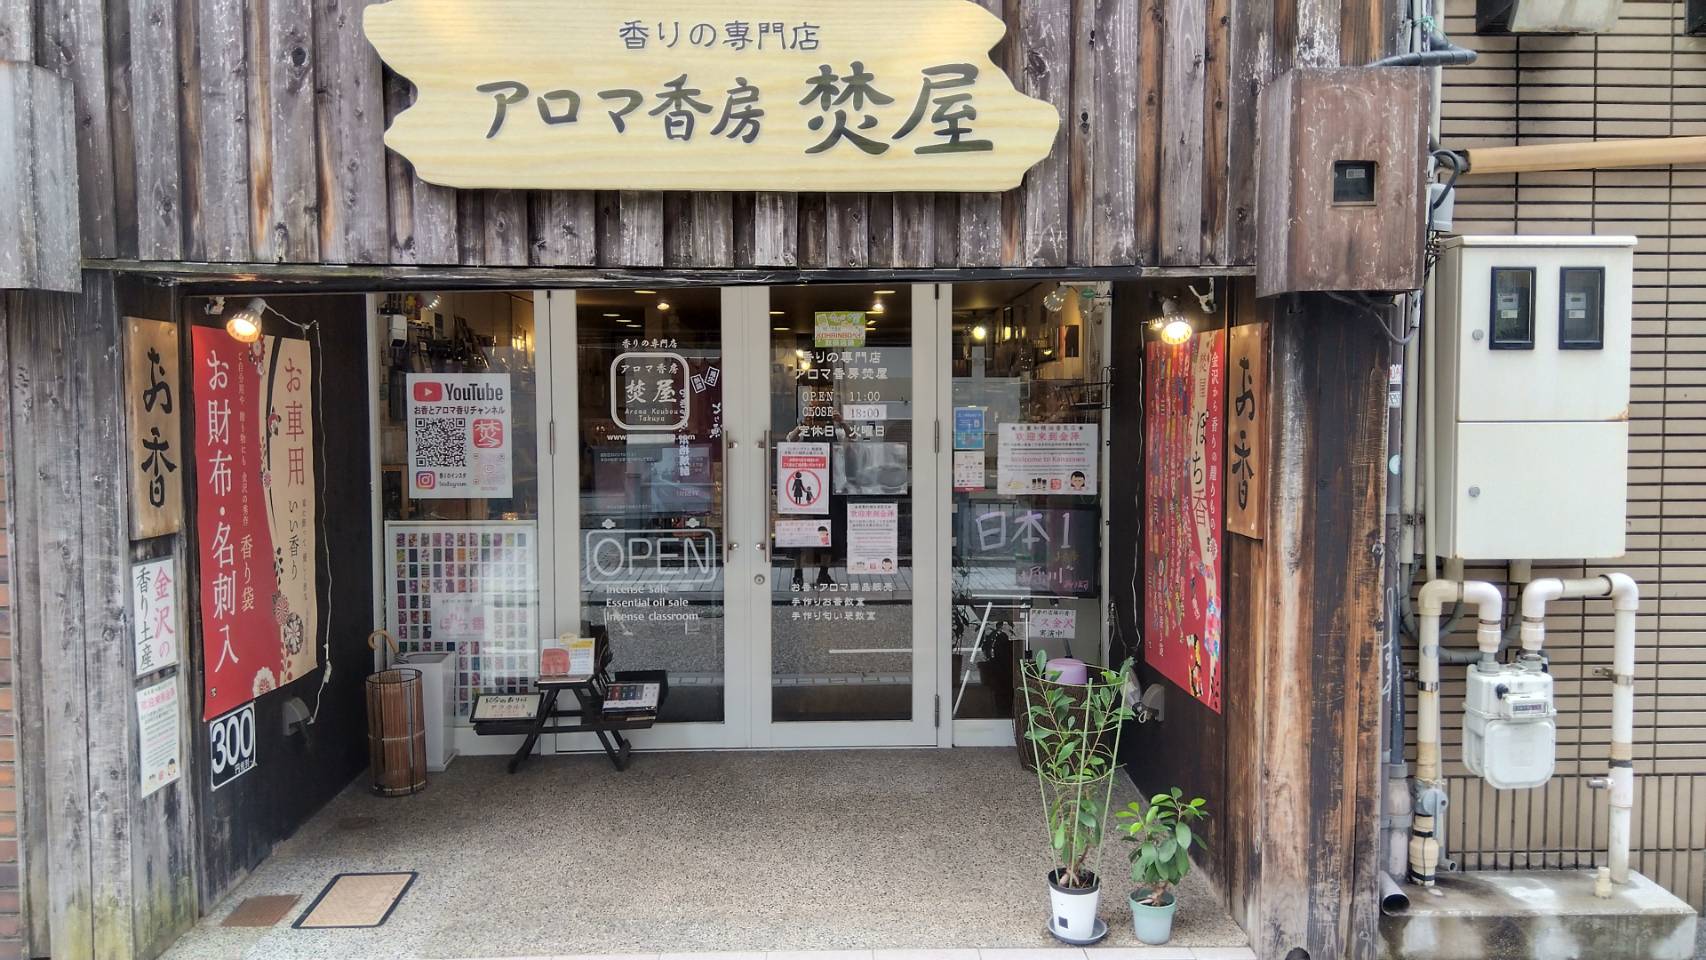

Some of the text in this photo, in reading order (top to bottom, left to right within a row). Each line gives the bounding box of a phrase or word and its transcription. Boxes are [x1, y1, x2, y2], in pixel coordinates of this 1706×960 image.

[618, 20, 821, 50] 香りの専門店
[475, 61, 994, 156] アロマ香房 焚屋
[621, 338, 678, 349] 香りの専門店
[802, 351, 881, 364] 香りの専門店
[620, 362, 679, 374] アロマ香房
[795, 367, 888, 380] アロマ香房焚屋
[445, 382, 504, 401] YouTube
[625, 378, 677, 404] 焚屋
[802, 391, 881, 402] OPEN 11:00
[414, 405, 506, 415] お香とアロマ香りチャンネル
[802, 406, 880, 418] CLOSE 18:00
[141, 347, 178, 509] お香
[284, 357, 305, 487] お車用
[798, 425, 885, 438] 定休日 火曜日
[1231, 356, 1255, 511] お香
[206, 350, 240, 673] お財布・名刺入
[593, 537, 709, 576] OPEN
[791, 583, 893, 592] お香・アロマ商品販売
[153, 566, 174, 658] 金沢の
[606, 598, 689, 608] Essential oil sale
[136, 566, 154, 671] 香り土産
[606, 611, 699, 621] Incense classroom
[212, 708, 254, 775] 300
